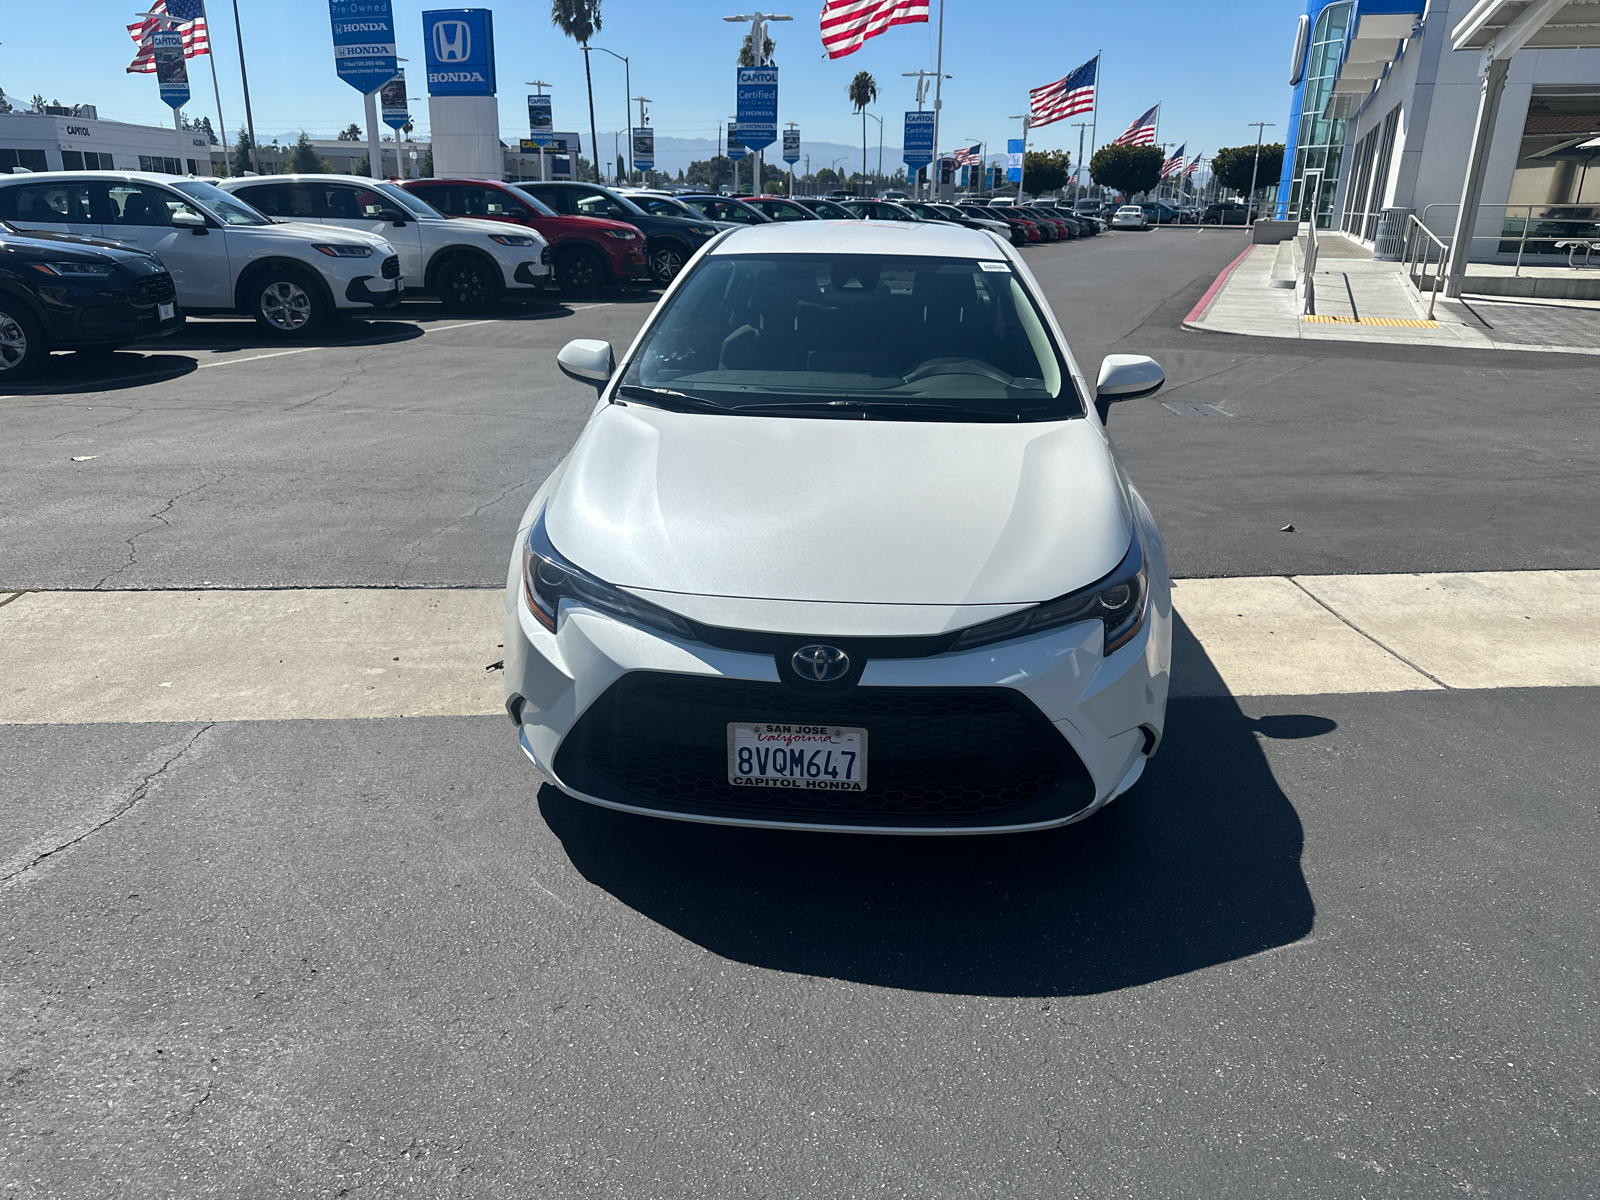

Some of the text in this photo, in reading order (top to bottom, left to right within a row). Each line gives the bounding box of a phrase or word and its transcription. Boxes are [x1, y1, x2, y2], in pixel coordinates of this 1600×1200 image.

[332, 2, 387, 14] Pre-Owned
[343, 23, 388, 32] HONDA
[154, 37, 182, 46] CAPITOL
[346, 46, 389, 55] HONDA
[428, 72, 485, 83] HONDA
[741, 73, 777, 82] CAPITOL
[738, 90, 776, 99] Certified
[907, 115, 934, 123] CAPITOL
[67, 126, 90, 136] CAPITOL
[766, 725, 827, 734] SAN JOSE
[738, 747, 856, 779] 8VQM647
[733, 777, 861, 791] CAPITOL HONDA
